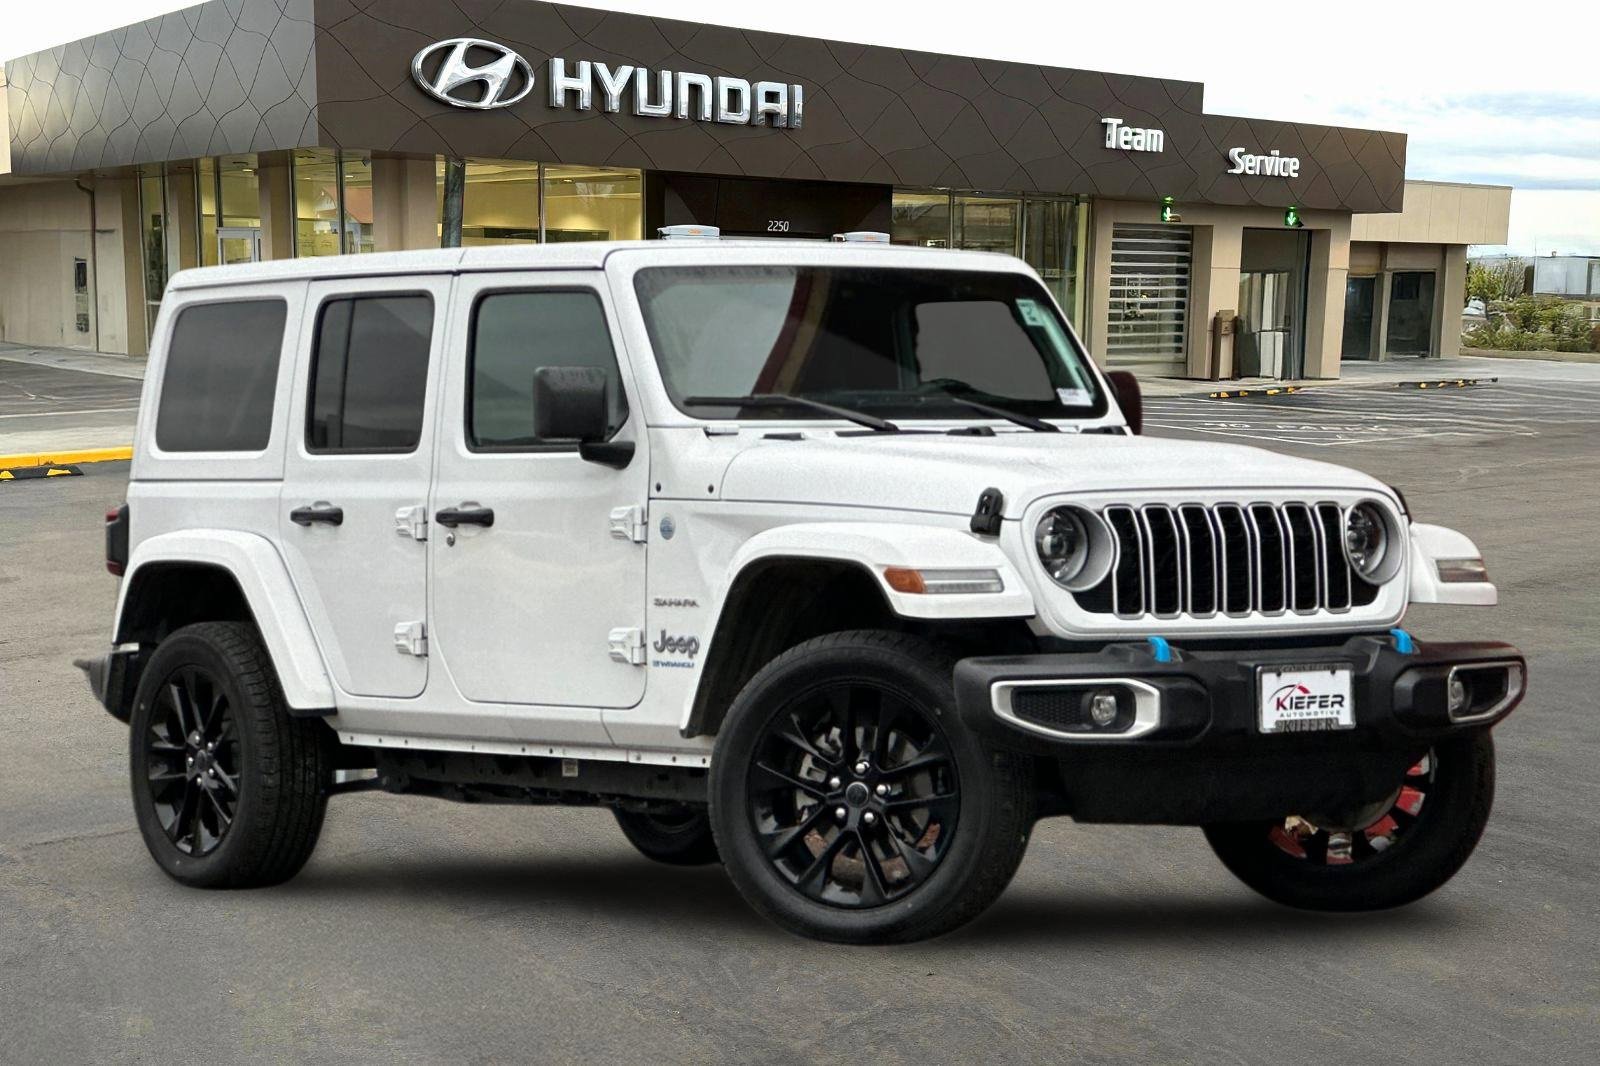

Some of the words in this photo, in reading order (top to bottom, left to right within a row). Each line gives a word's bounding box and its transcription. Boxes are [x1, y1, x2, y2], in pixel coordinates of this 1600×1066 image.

[549, 57, 803, 129] HYUNDAI
[1101, 117, 1164, 153] Team
[1227, 147, 1300, 178] Service
[767, 220, 789, 232] 2250
[653, 629, 700, 659] Jeep
[1276, 694, 1345, 711] KIEFER
[1280, 710, 1341, 718] AUTOMOTIVE
